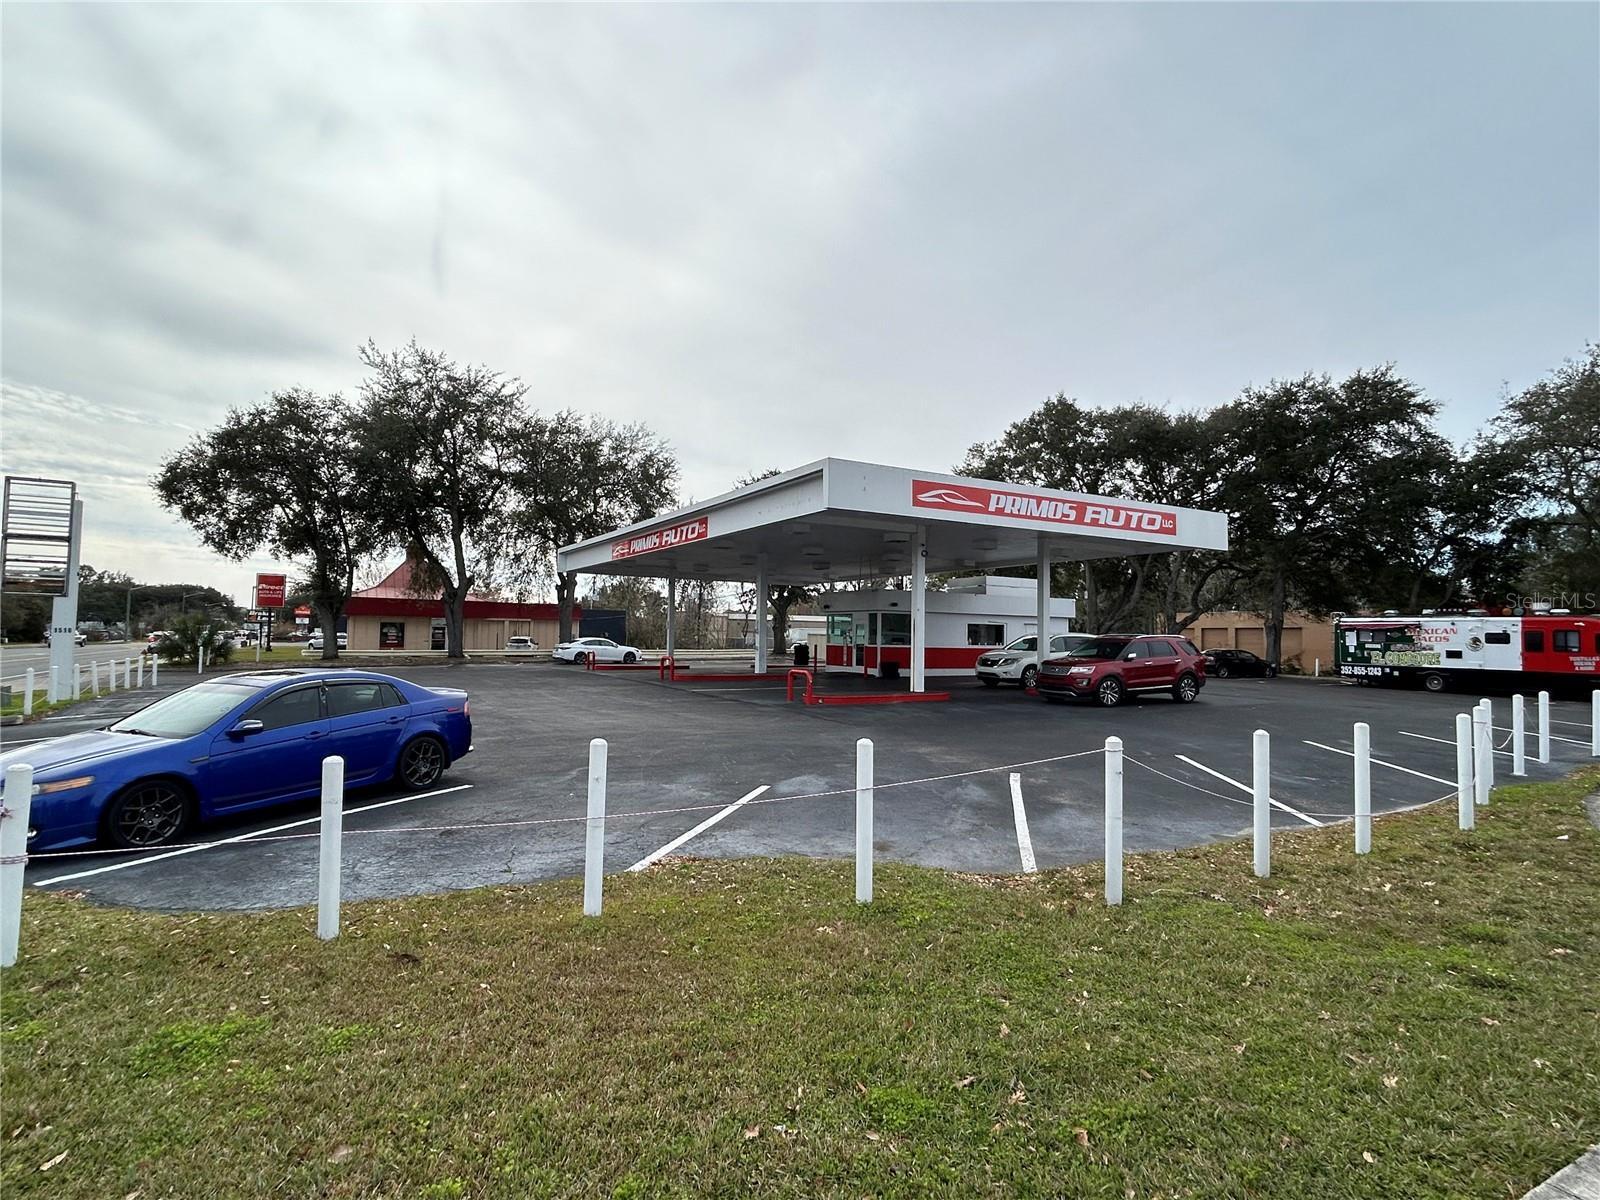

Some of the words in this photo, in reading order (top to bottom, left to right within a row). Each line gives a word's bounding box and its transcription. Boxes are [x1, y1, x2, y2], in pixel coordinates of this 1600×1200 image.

[988, 493, 1077, 521] PRIMOS
[1083, 505, 1162, 530] AUTO
[1162, 519, 1173, 528] LLC
[630, 532, 660, 553] PRIMOS
[662, 522, 699, 546] AUTO
[1405, 625, 1457, 635] MEXICAN
